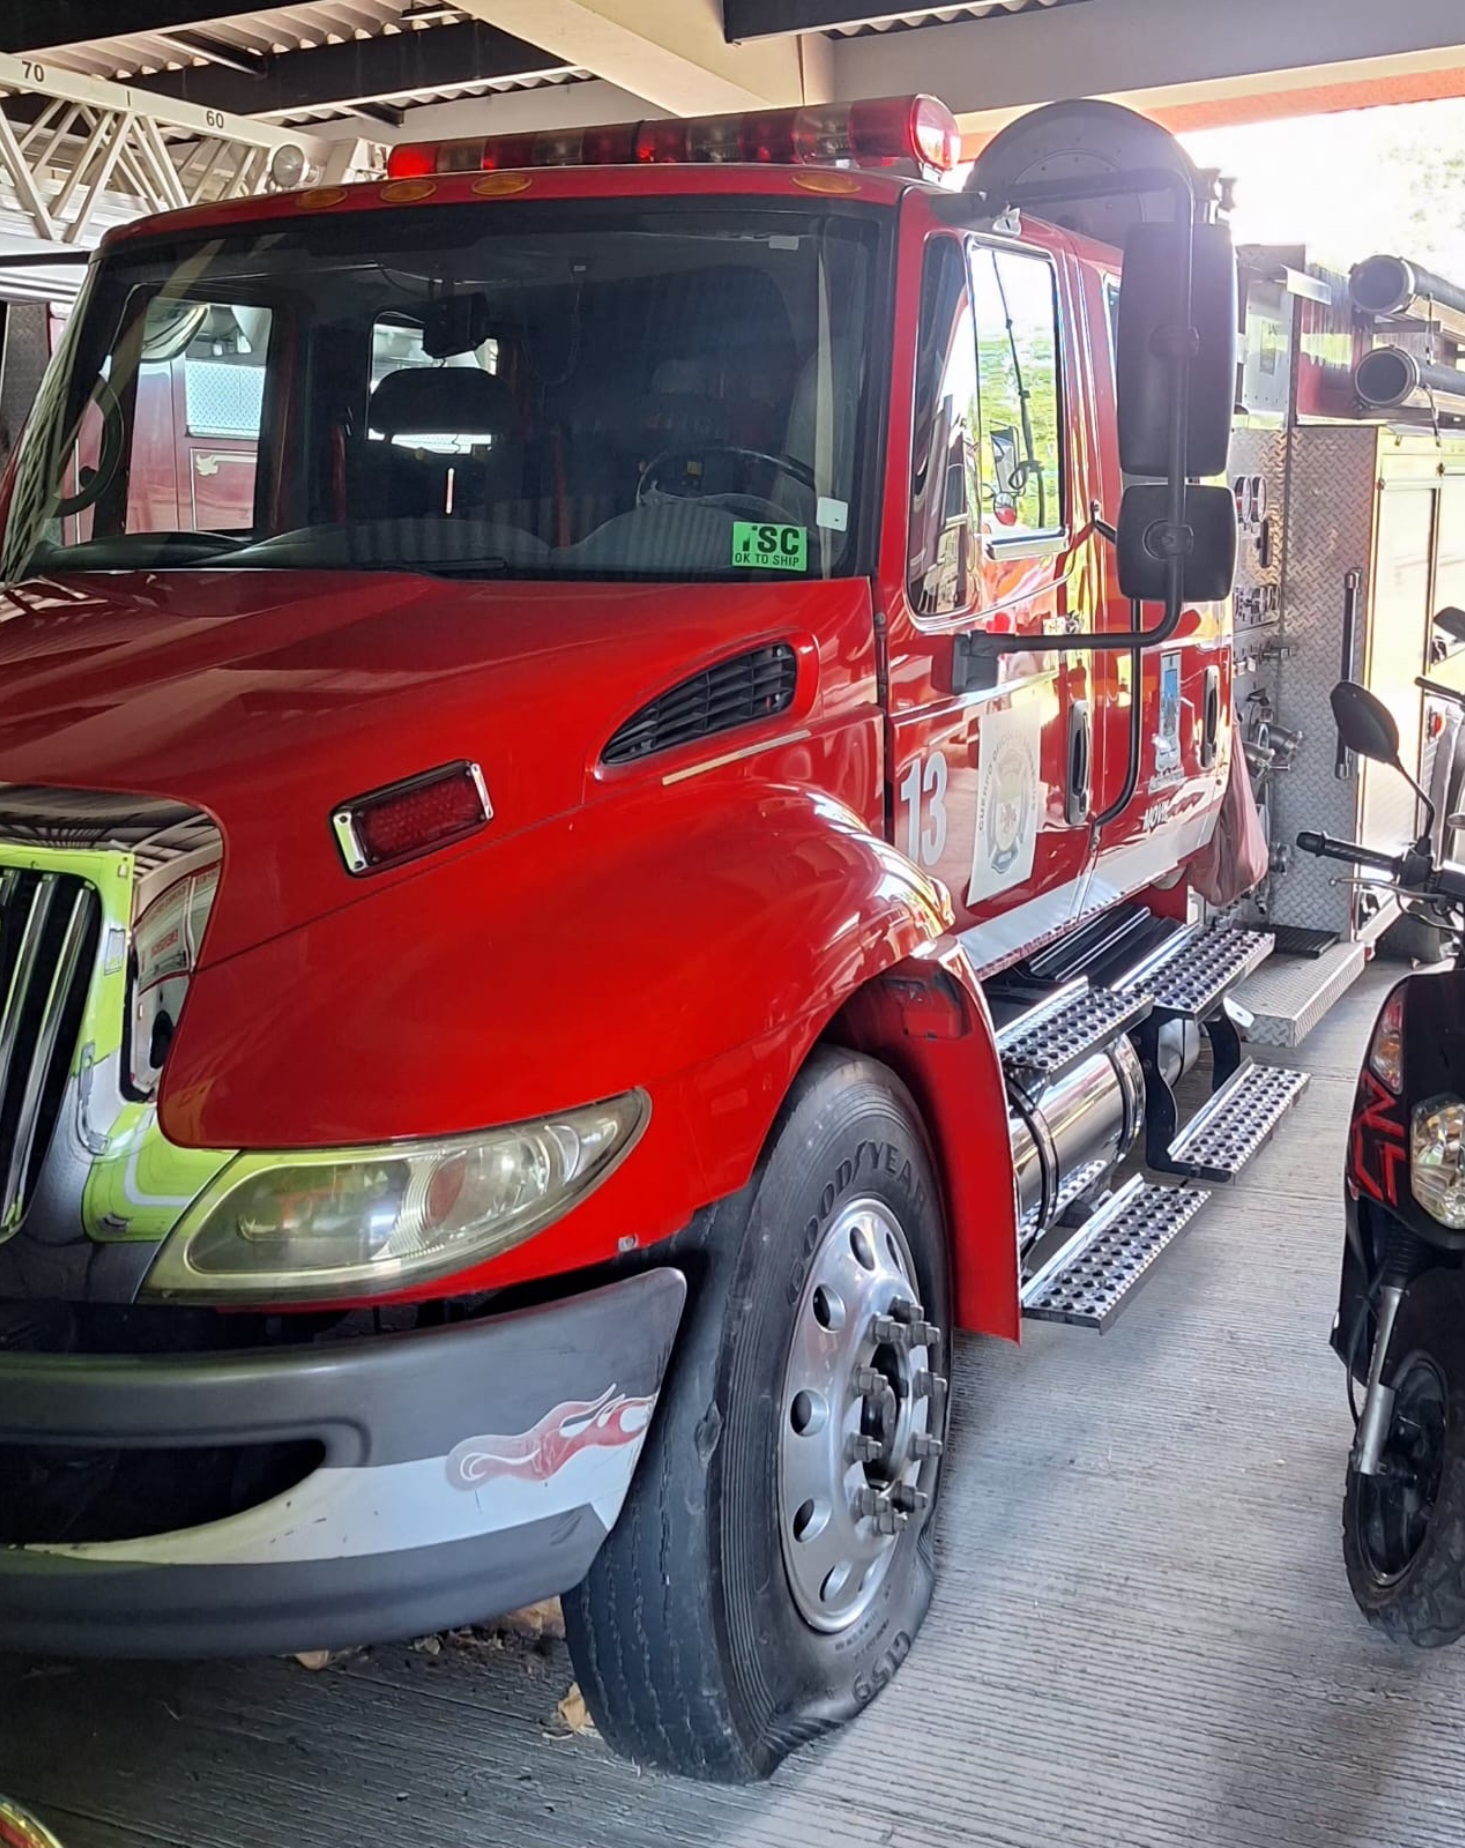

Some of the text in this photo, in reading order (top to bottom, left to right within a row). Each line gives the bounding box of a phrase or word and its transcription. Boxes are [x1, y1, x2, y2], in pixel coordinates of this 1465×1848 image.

[22, 60, 45, 83] 70
[206, 109, 225, 129] 60
[735, 552, 799, 567] OK TO SHIP
[901, 751, 947, 866] 13
